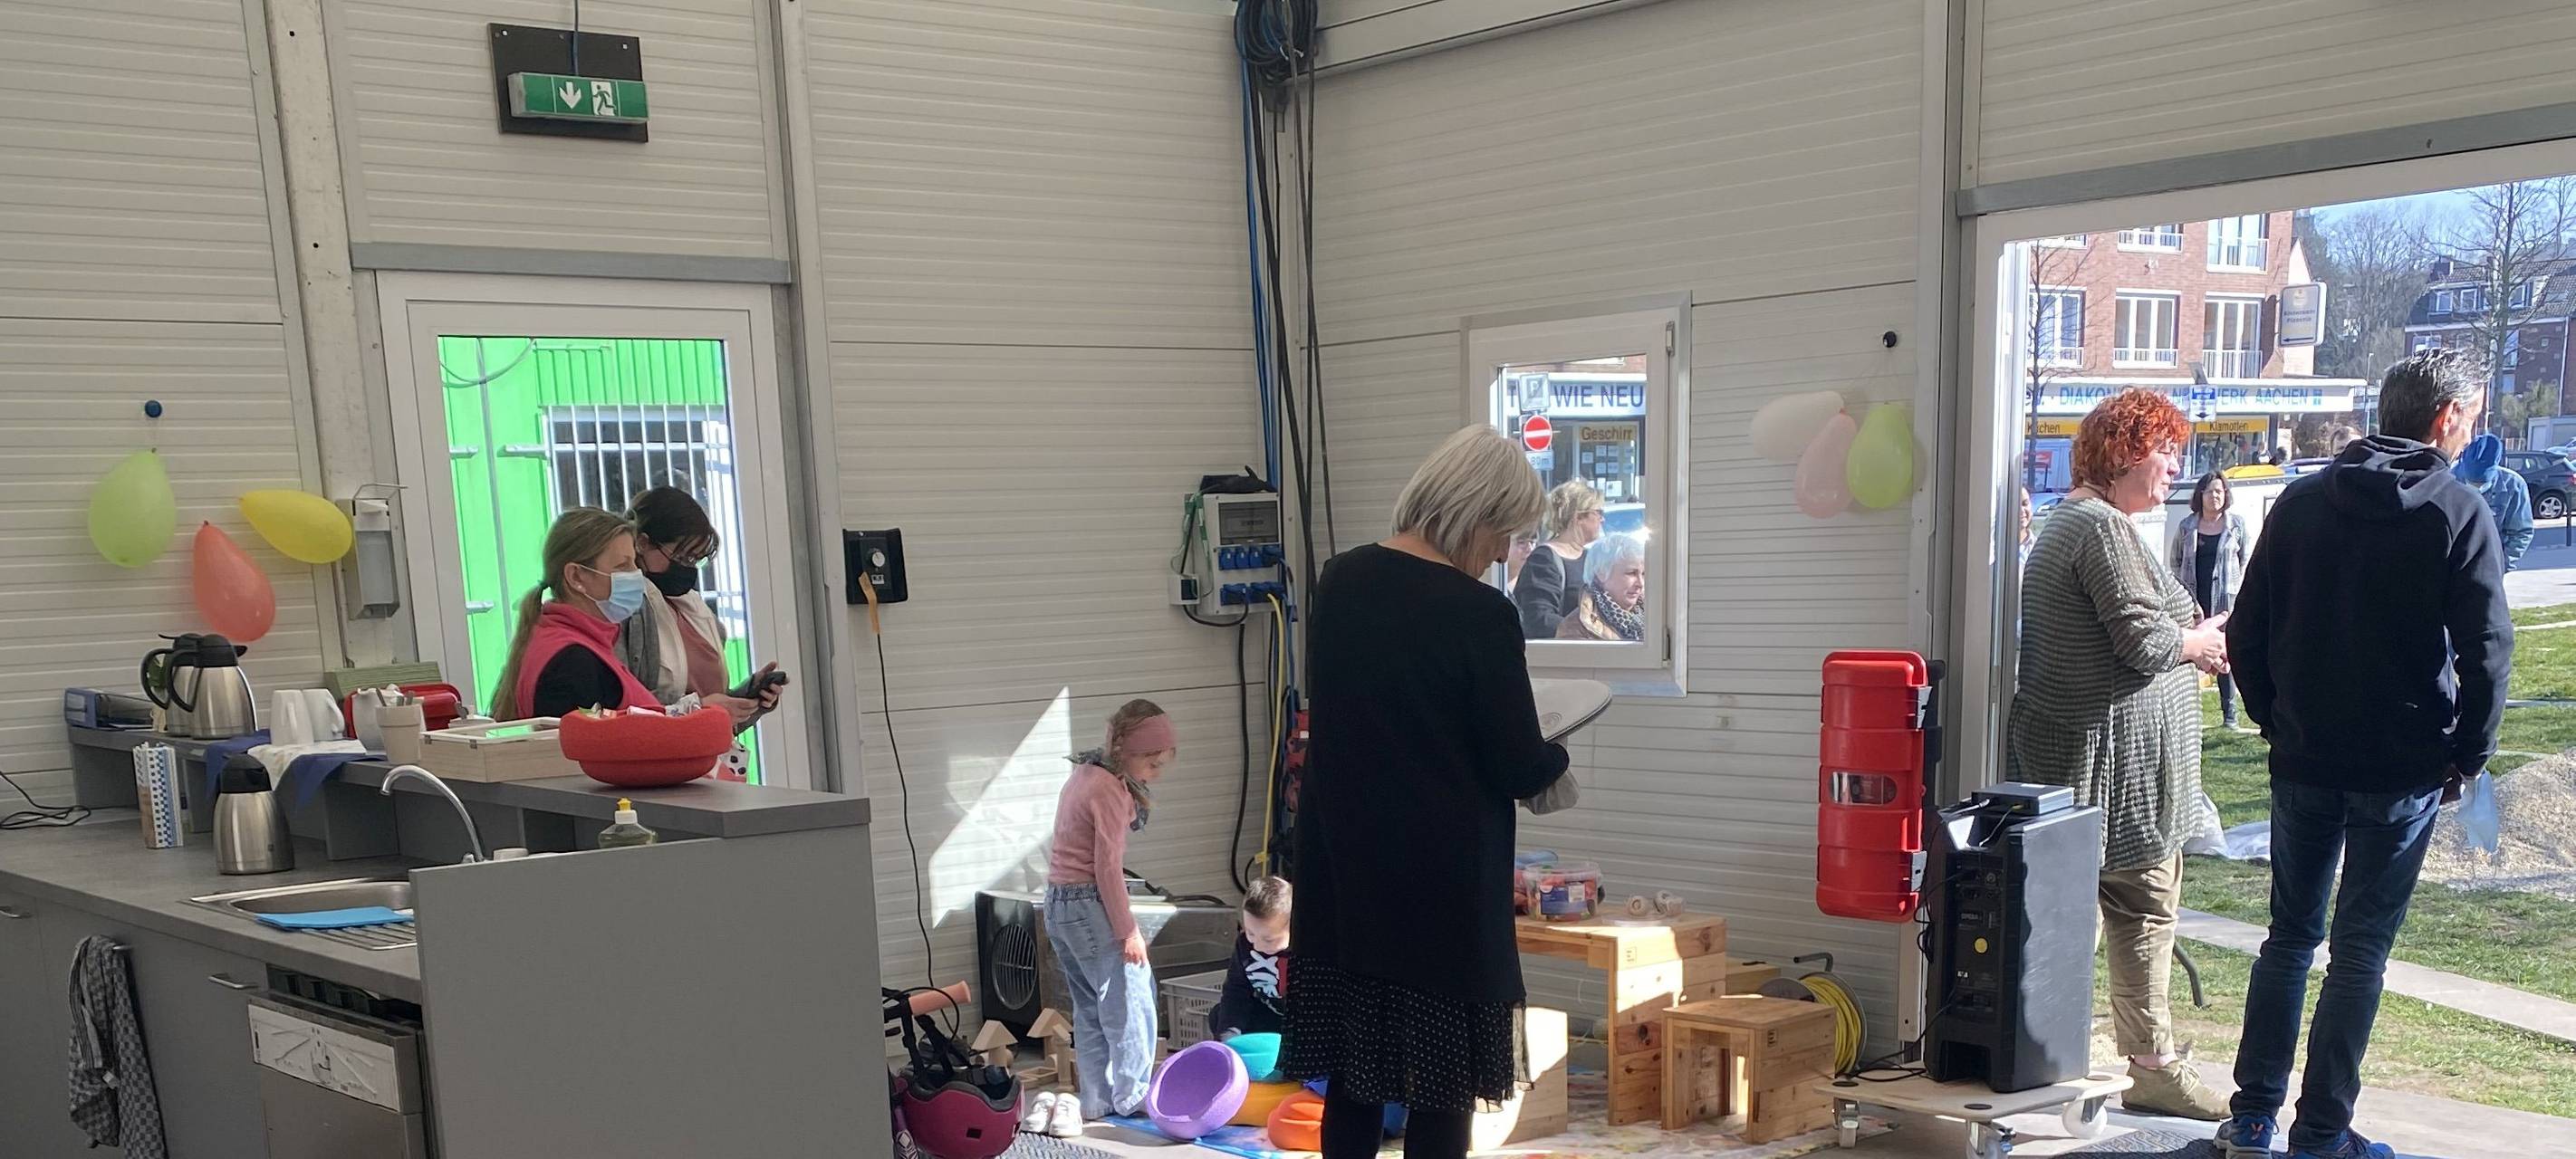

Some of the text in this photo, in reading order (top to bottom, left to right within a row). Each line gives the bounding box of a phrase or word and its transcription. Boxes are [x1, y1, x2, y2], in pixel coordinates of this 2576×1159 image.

[1553, 384, 1593, 407] WIE
[1600, 384, 1644, 407] NEU
[2254, 388, 2308, 405] AACHEN
